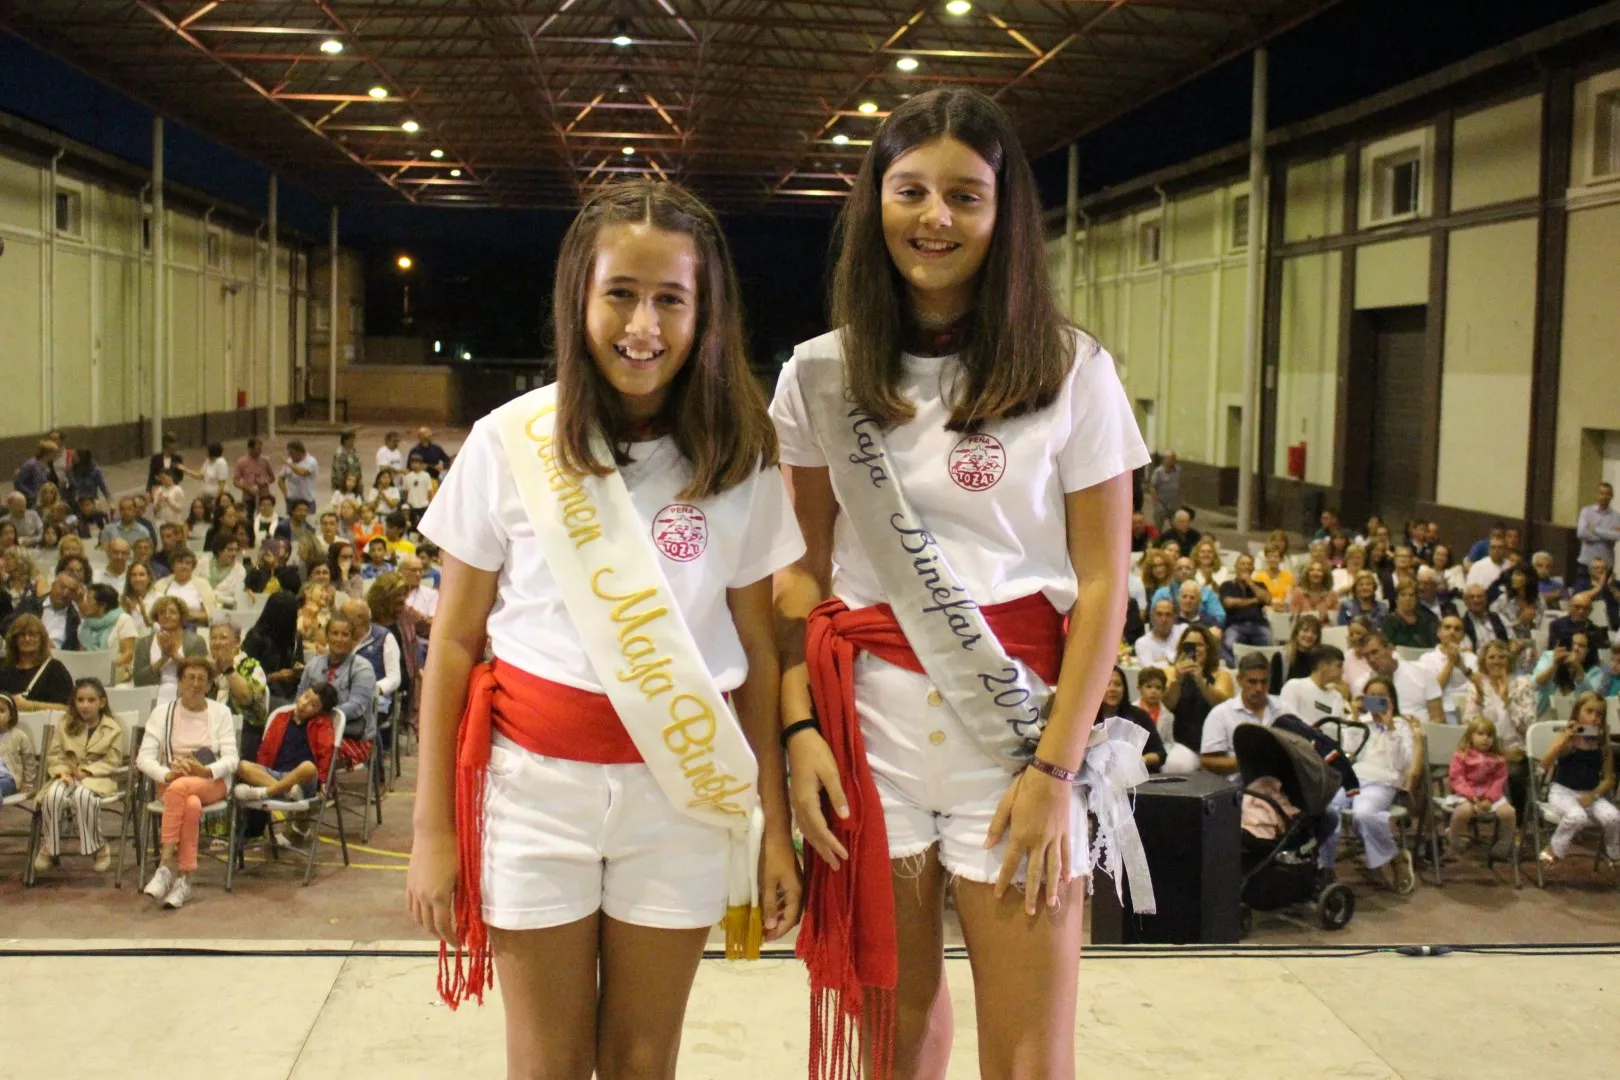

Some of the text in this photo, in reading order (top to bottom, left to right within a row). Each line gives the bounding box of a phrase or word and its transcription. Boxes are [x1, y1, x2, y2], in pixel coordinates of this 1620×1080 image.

[968, 436, 990, 445] PEÑA
[958, 471, 994, 487] TOZAL
[591, 566, 674, 702] Maja
[890, 512, 983, 651] Binéfar
[977, 667, 1041, 743] 202
